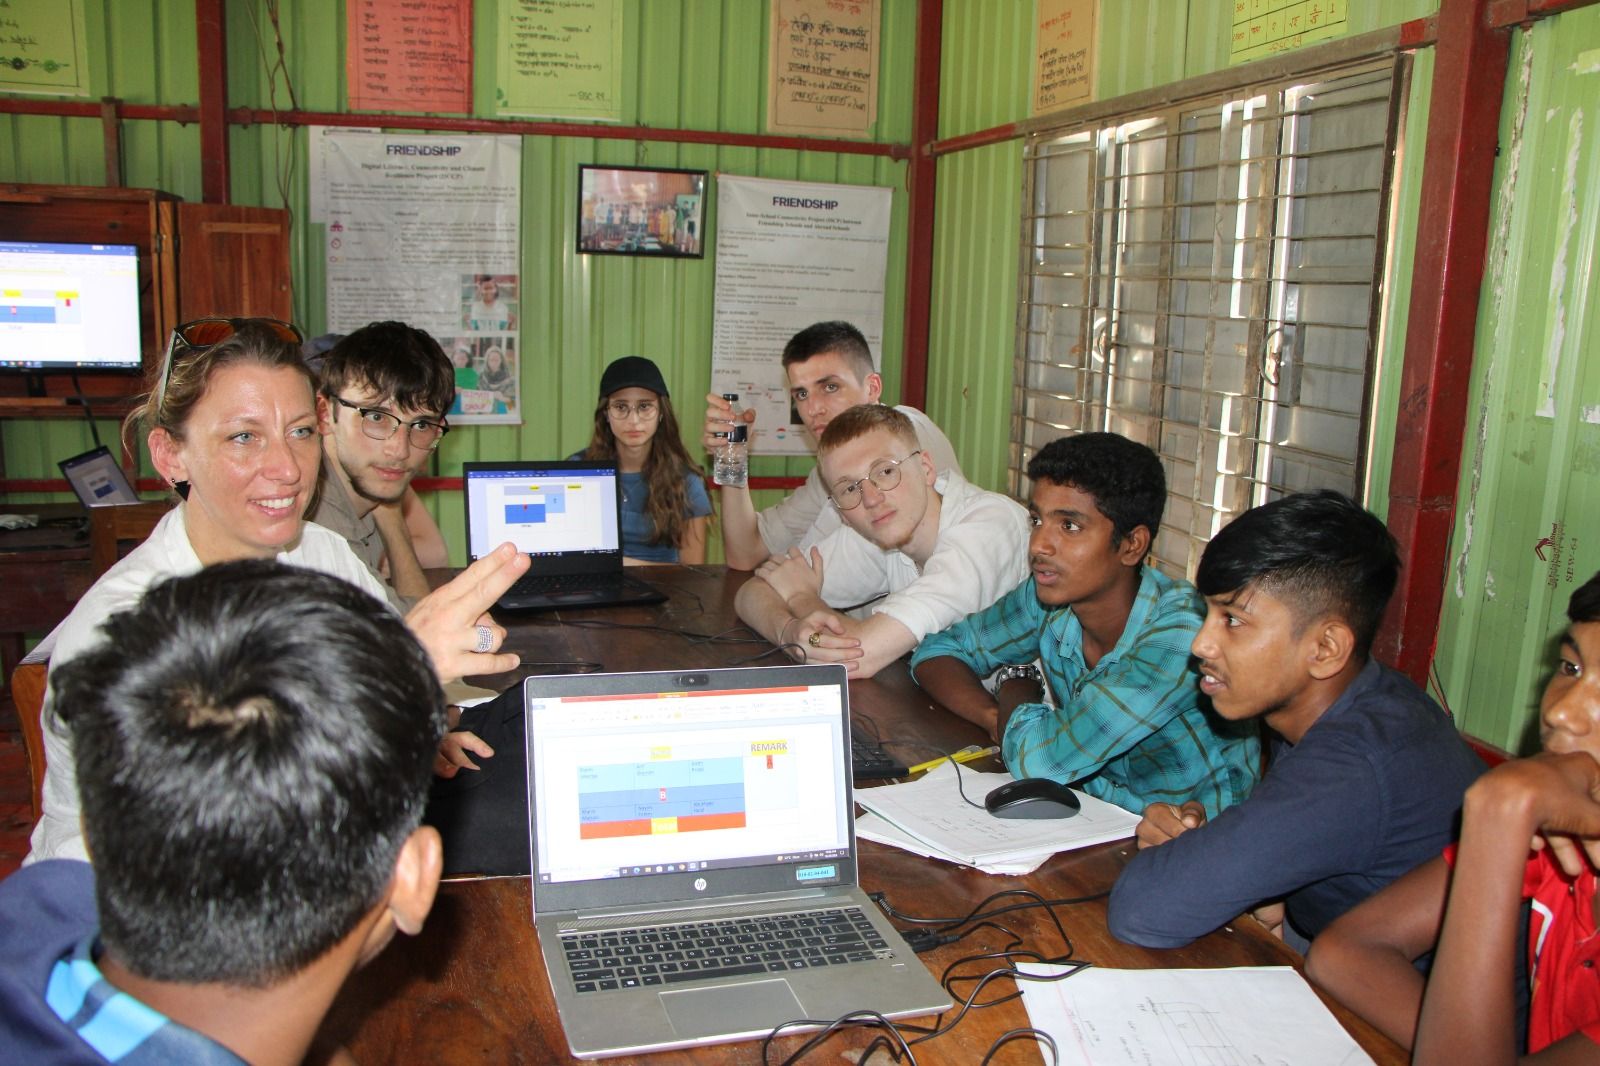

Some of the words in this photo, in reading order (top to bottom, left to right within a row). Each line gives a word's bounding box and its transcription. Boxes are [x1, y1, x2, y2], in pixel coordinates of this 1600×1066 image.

[386, 144, 462, 157] FRIENDSHIP
[773, 196, 839, 211] FRIENDSHIP
[750, 742, 788, 753] REMARK
